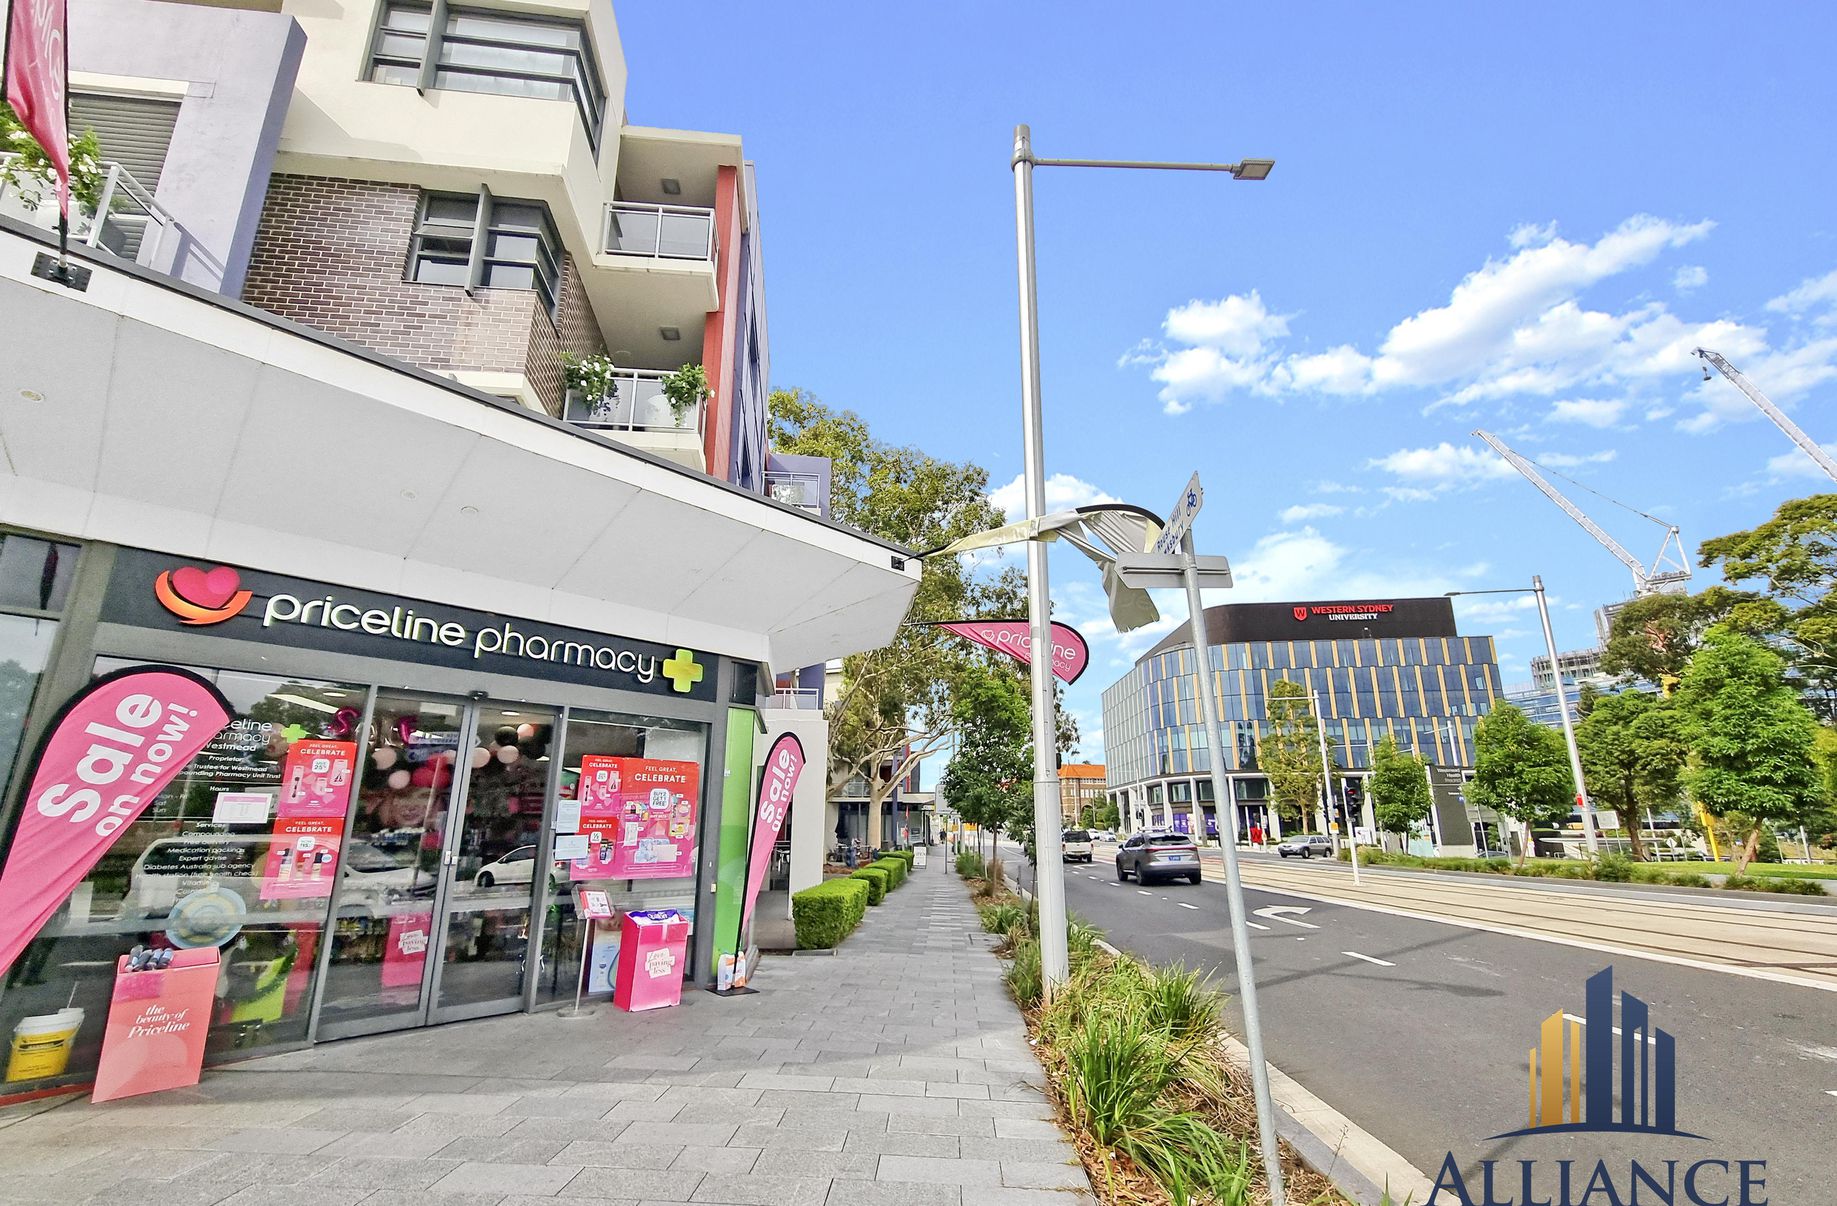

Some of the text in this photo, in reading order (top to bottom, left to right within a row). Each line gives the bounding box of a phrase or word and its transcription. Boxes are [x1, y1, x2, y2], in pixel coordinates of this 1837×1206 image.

[1311, 604, 1394, 614] WESTERN SYDNEY
[1328, 613, 1378, 621] UNIVERSITY
[263, 594, 656, 684] priceline pharmacy
[996, 629, 1076, 661] pricine
[225, 718, 272, 732] eline
[214, 732, 271, 746] armacy
[37, 694, 162, 823] Sale
[300, 748, 346, 756] CELEBRATE
[95, 702, 198, 837] on now!
[634, 773, 687, 783] CELEBRATE
[760, 749, 790, 824] Sale
[771, 807, 783, 832] on
[136, 1008, 189, 1024] beauty of
[145, 1004, 165, 1016] the
[128, 1021, 190, 1039] Priceline
